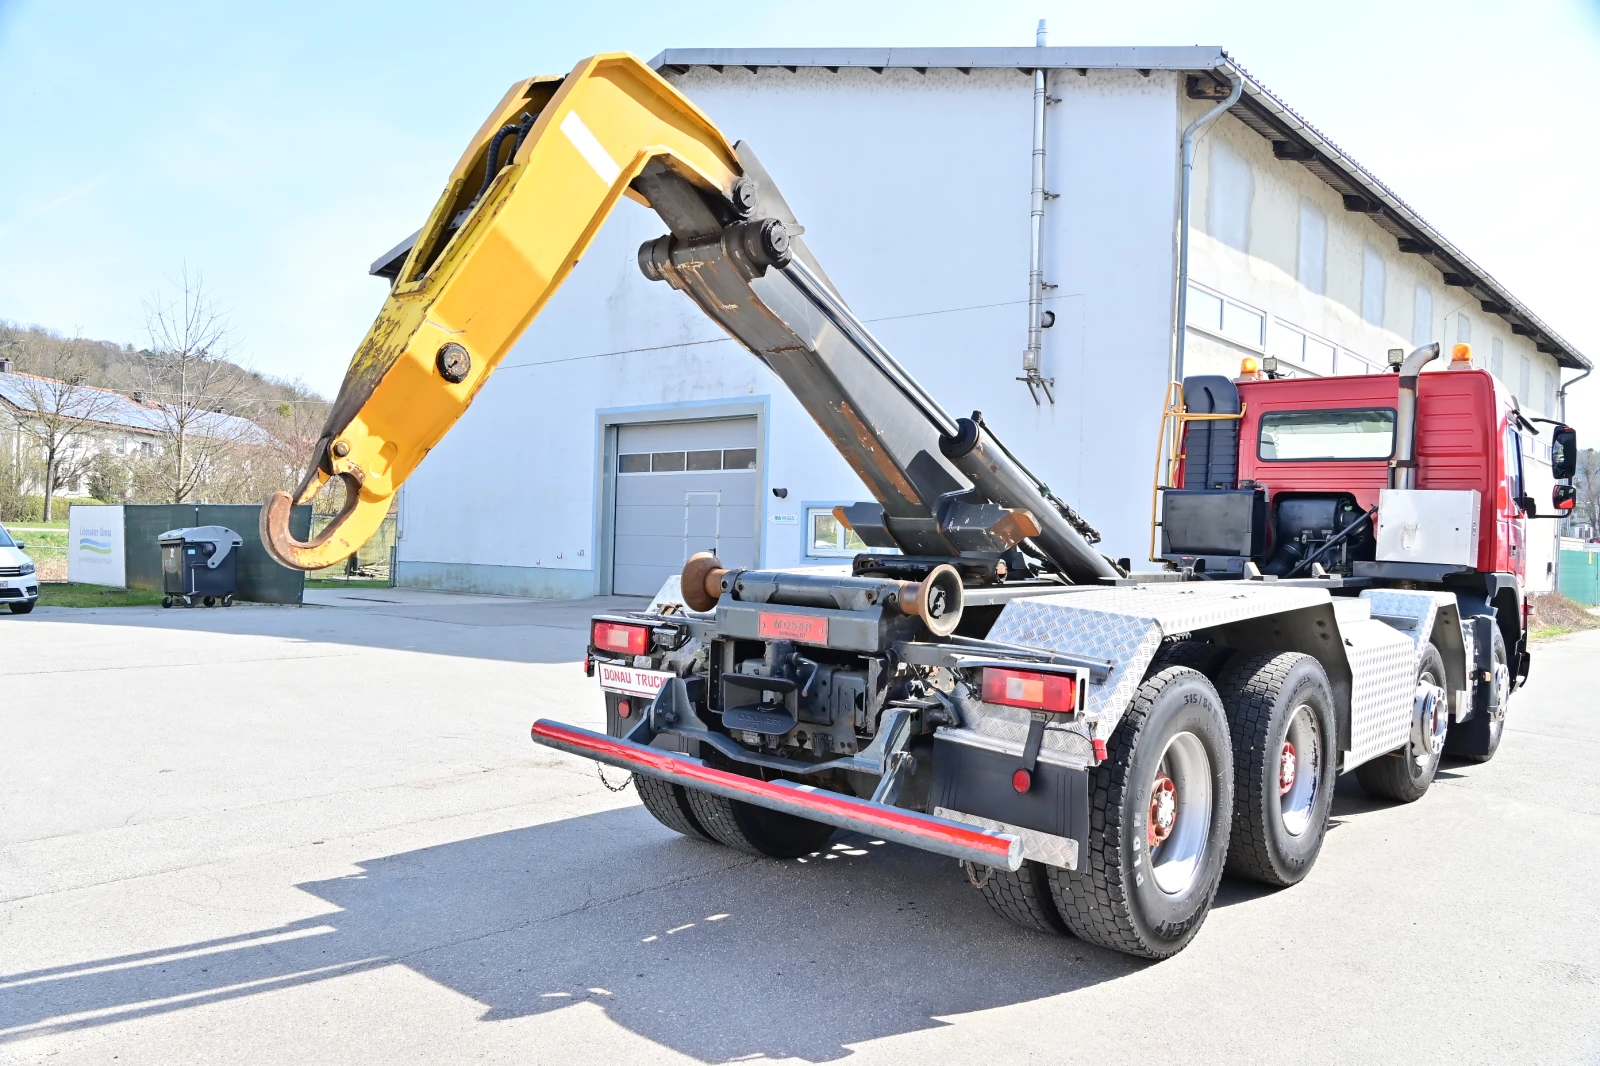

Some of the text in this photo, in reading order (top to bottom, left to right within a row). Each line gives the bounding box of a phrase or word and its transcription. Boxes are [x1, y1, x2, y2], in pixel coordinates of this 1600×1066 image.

[773, 619, 812, 632] MOSER
[604, 668, 632, 684] DONAU
[1183, 693, 1213, 712] 315/80
